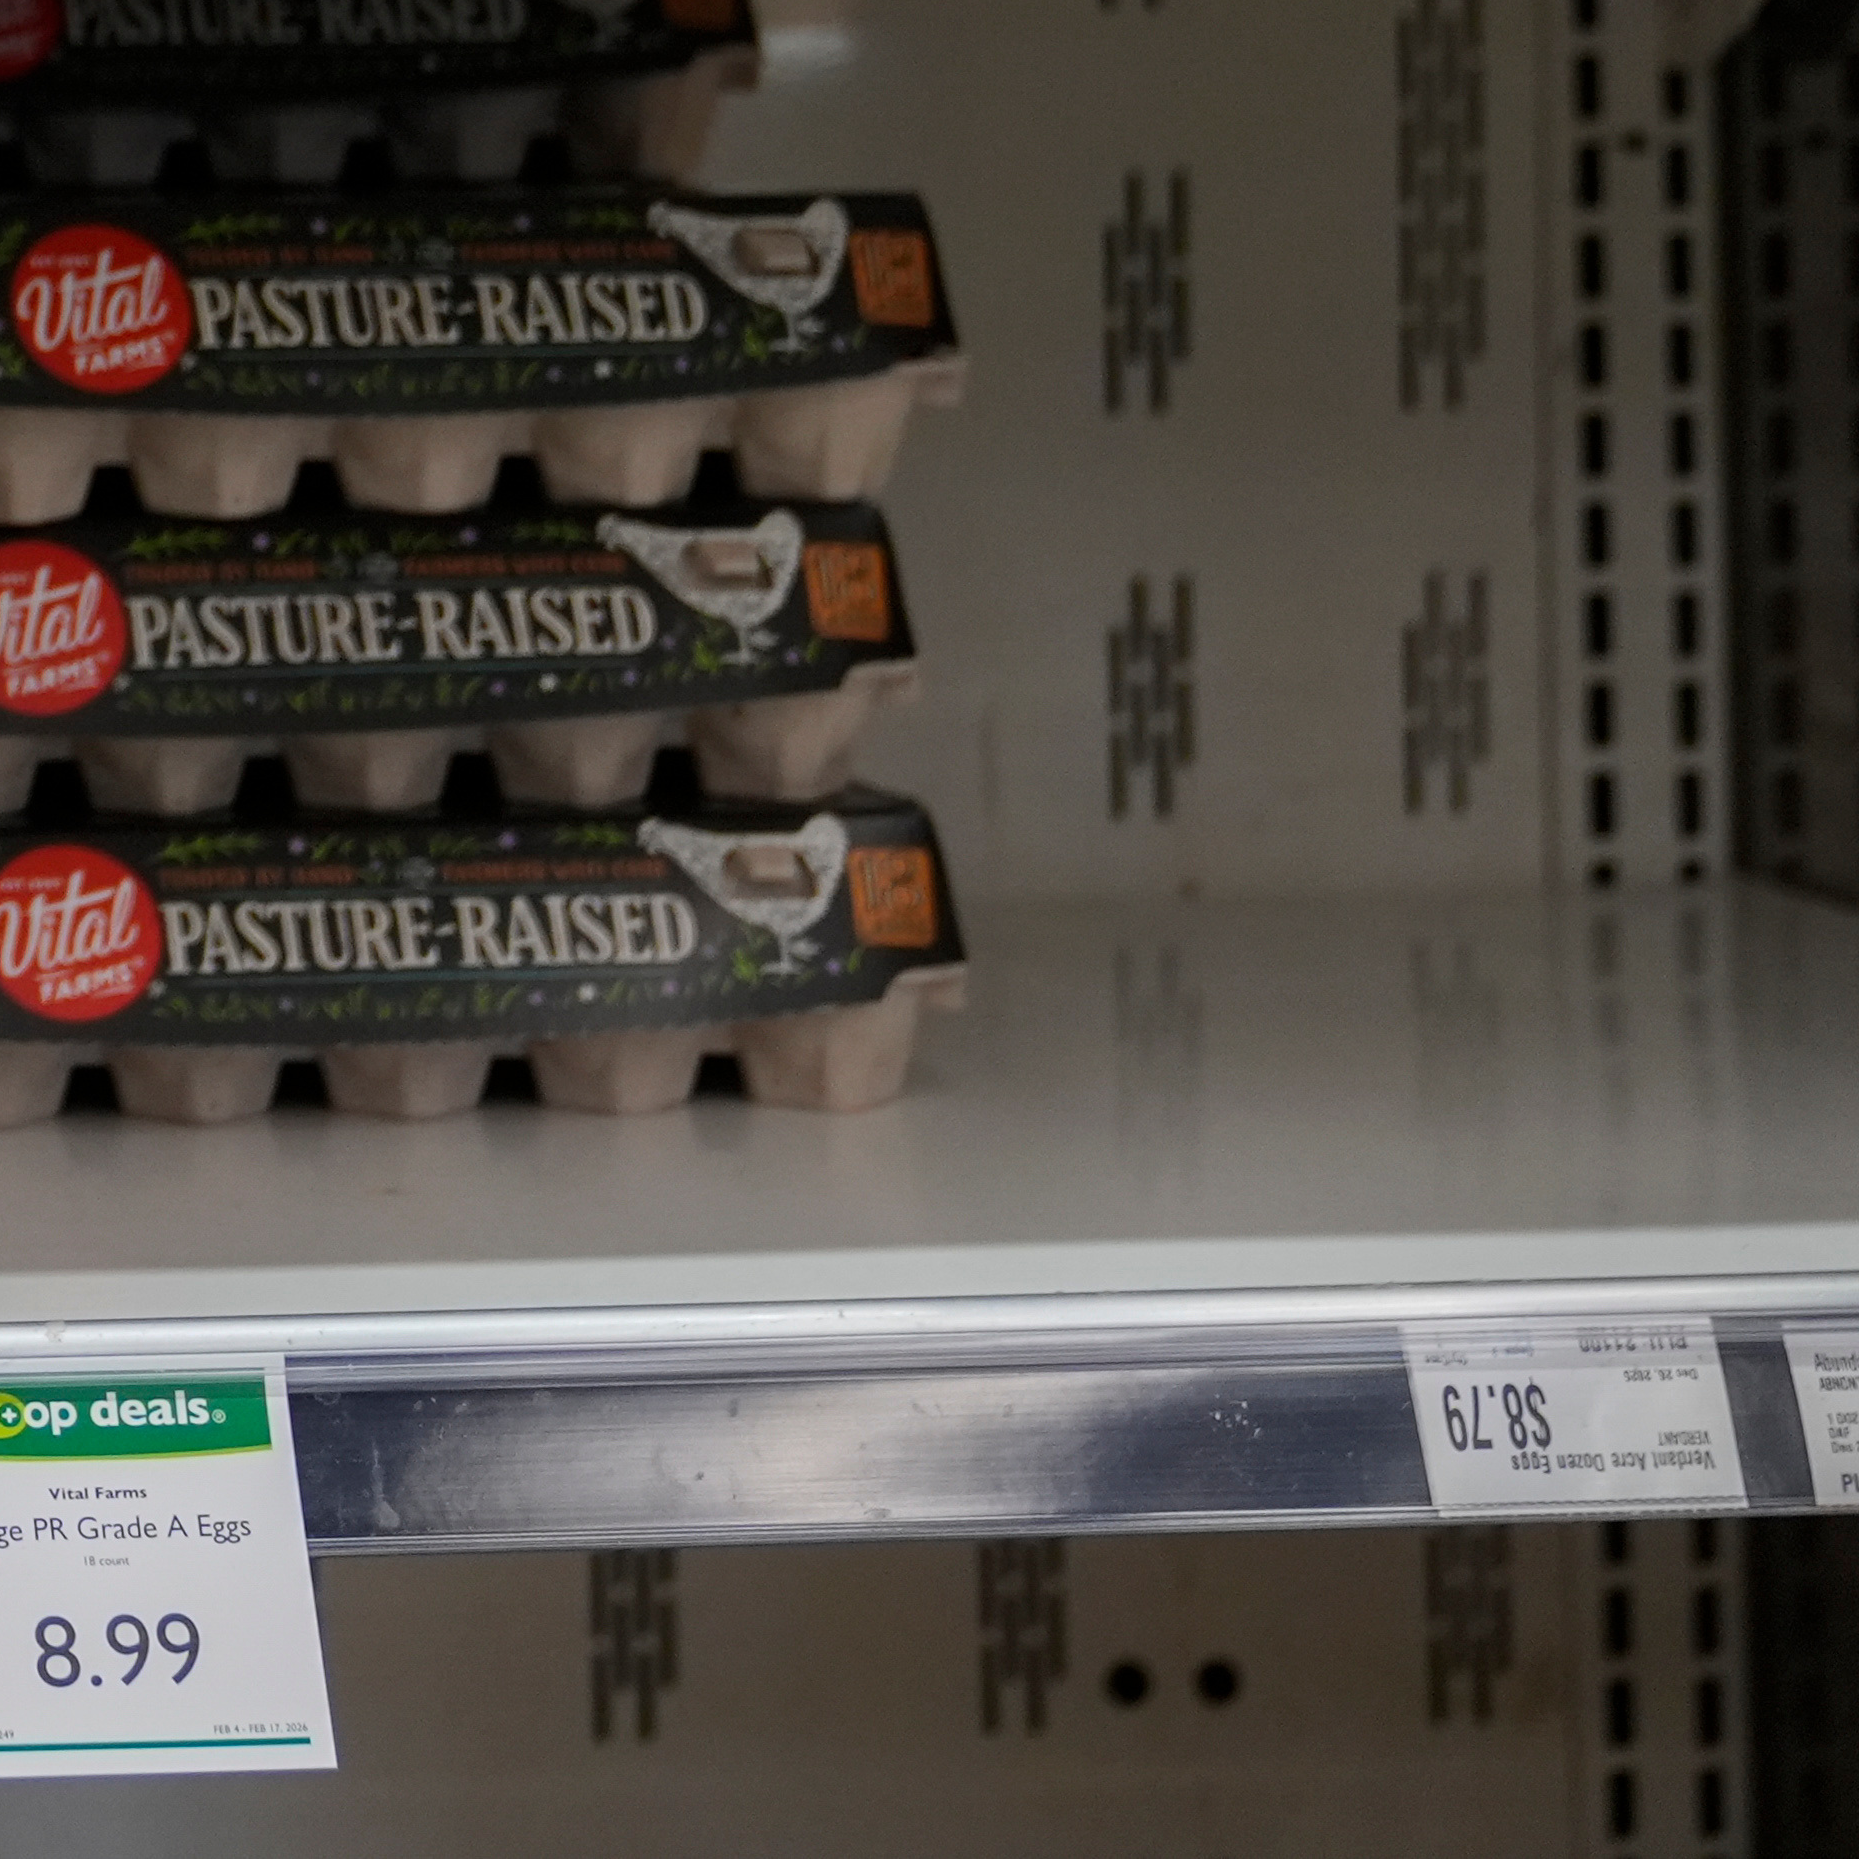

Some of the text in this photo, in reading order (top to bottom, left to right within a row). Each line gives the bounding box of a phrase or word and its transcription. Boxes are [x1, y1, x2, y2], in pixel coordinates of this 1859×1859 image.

[16, 248, 169, 353] Vital
[194, 272, 707, 351] PASTURE-RAISED
[125, 584, 656, 671] PASTURE-RAISED
[160, 894, 698, 976] PASTURE-RAISED
[1443, 1375, 1553, 1452] $8.79
[48, 1486, 147, 1501] Vital Farms
[1511, 1450, 1716, 1473] Verdant Acre Dozen Eggs
[33, 1517, 68, 1541] PR
[77, 1515, 157, 1540] Grade
[167, 1515, 189, 1538] A
[198, 1514, 252, 1544] Eggs
[34, 1612, 201, 1688] 8.99
